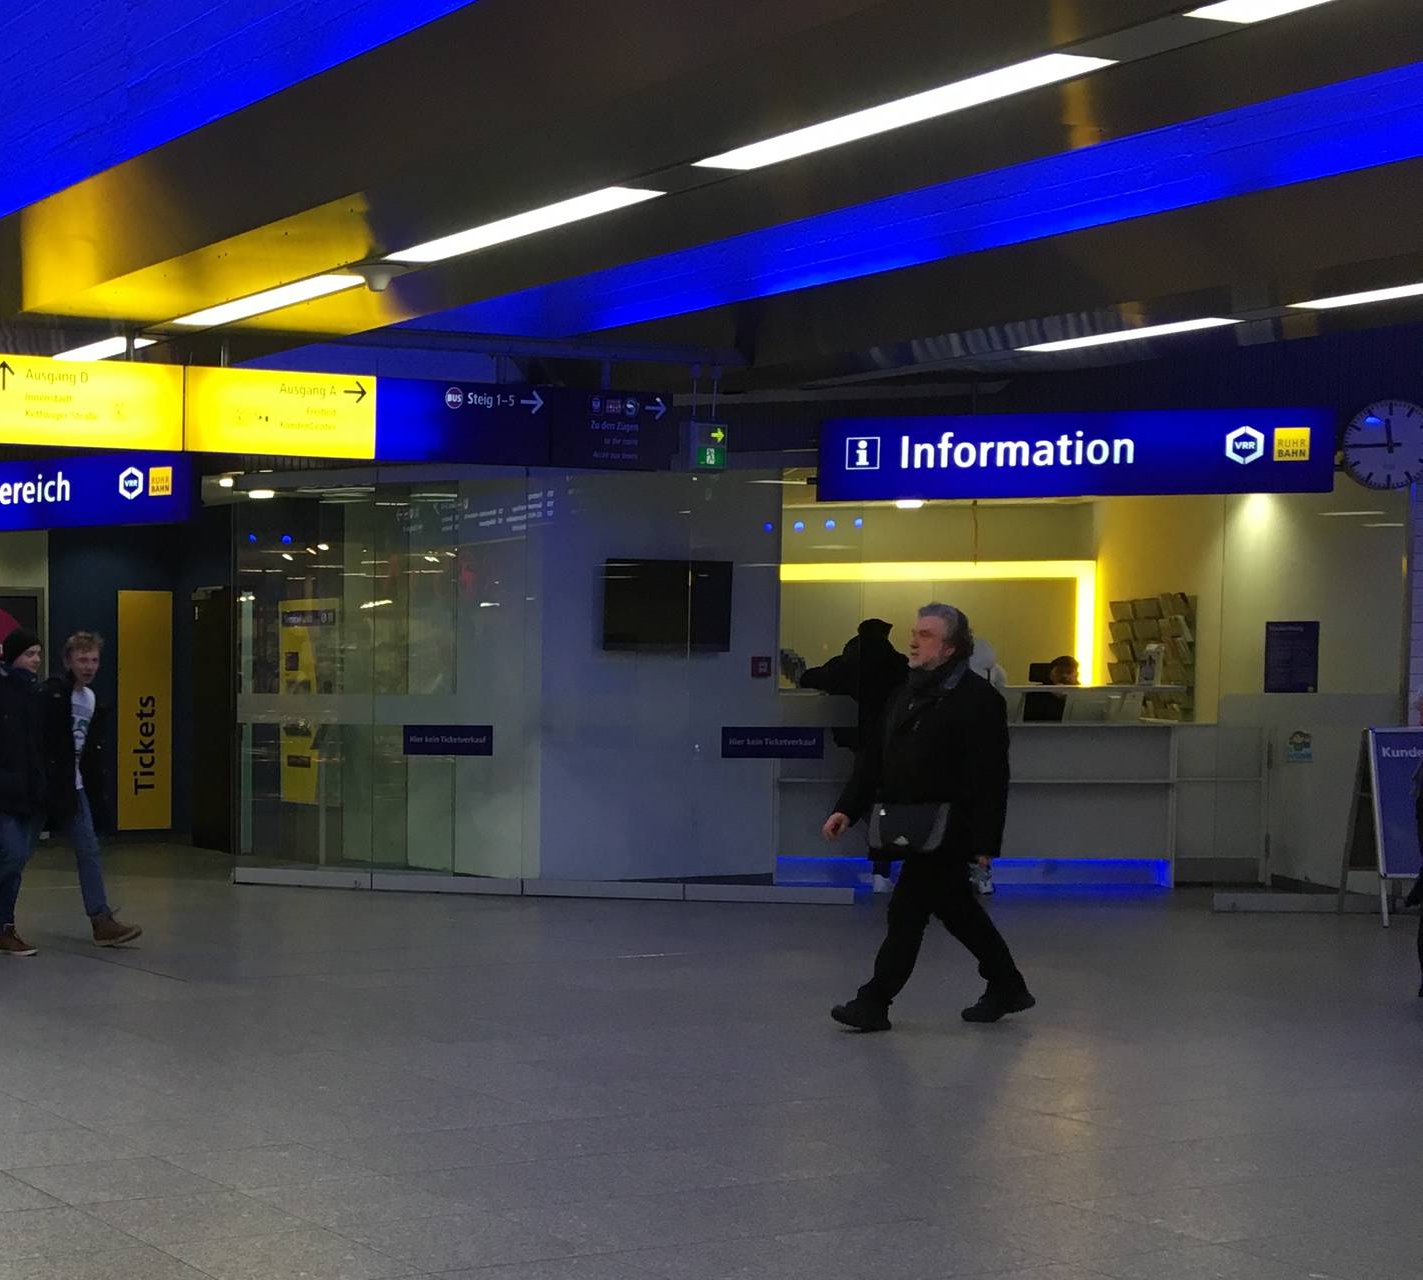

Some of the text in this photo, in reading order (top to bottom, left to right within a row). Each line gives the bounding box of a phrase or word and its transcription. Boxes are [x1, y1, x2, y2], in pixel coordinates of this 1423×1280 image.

[25, 368, 89, 386] Ausgang D
[279, 383, 337, 400] Ausgang A
[447, 394, 462, 403] BUS
[467, 392, 494, 409] Steig
[901, 430, 1135, 468] Information
[1234, 441, 1257, 450] VRR
[1276, 439, 1306, 448] RUHR
[1277, 449, 1306, 458] BAHN
[150, 484, 170, 493] BAHN
[133, 695, 155, 796] Tickets
